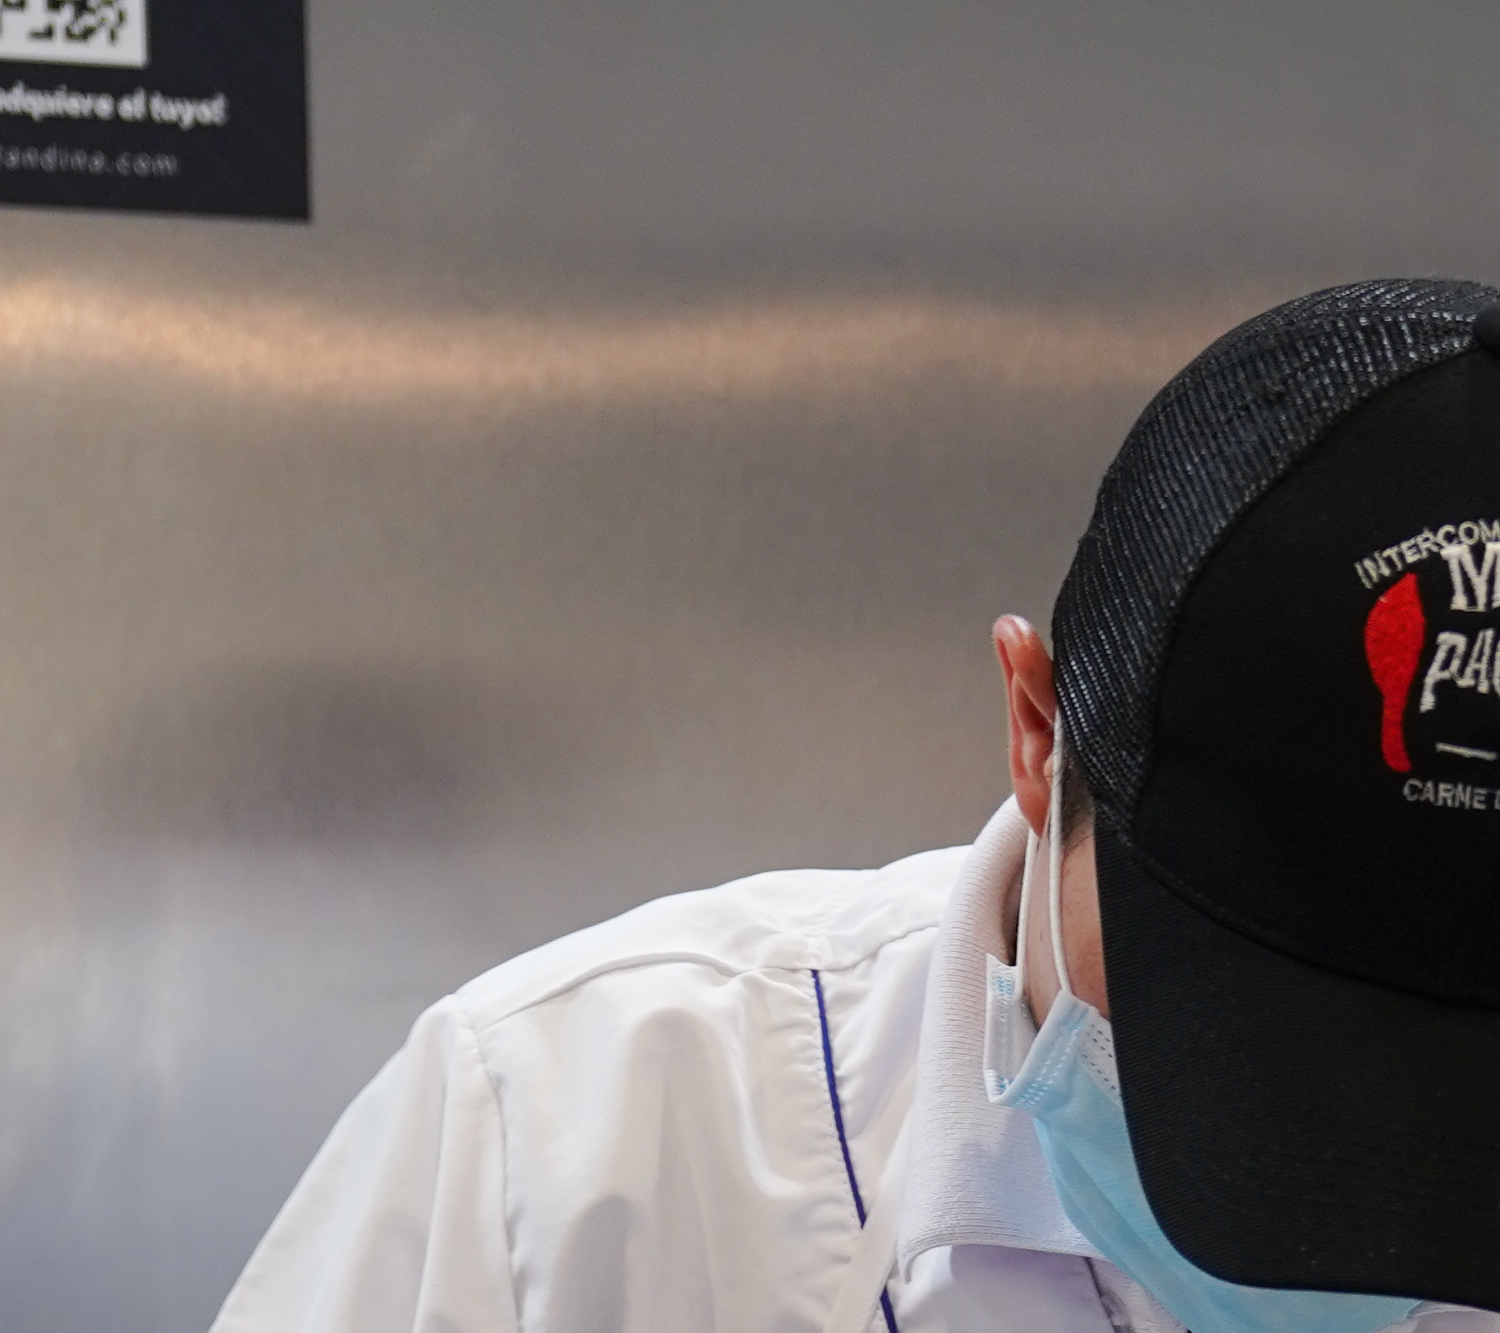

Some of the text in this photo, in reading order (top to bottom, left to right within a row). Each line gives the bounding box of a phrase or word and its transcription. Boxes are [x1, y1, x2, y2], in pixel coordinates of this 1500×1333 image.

[117, 87, 148, 122] el
[149, 90, 229, 131] tuyo!
[1402, 778, 1487, 810] CARNE
